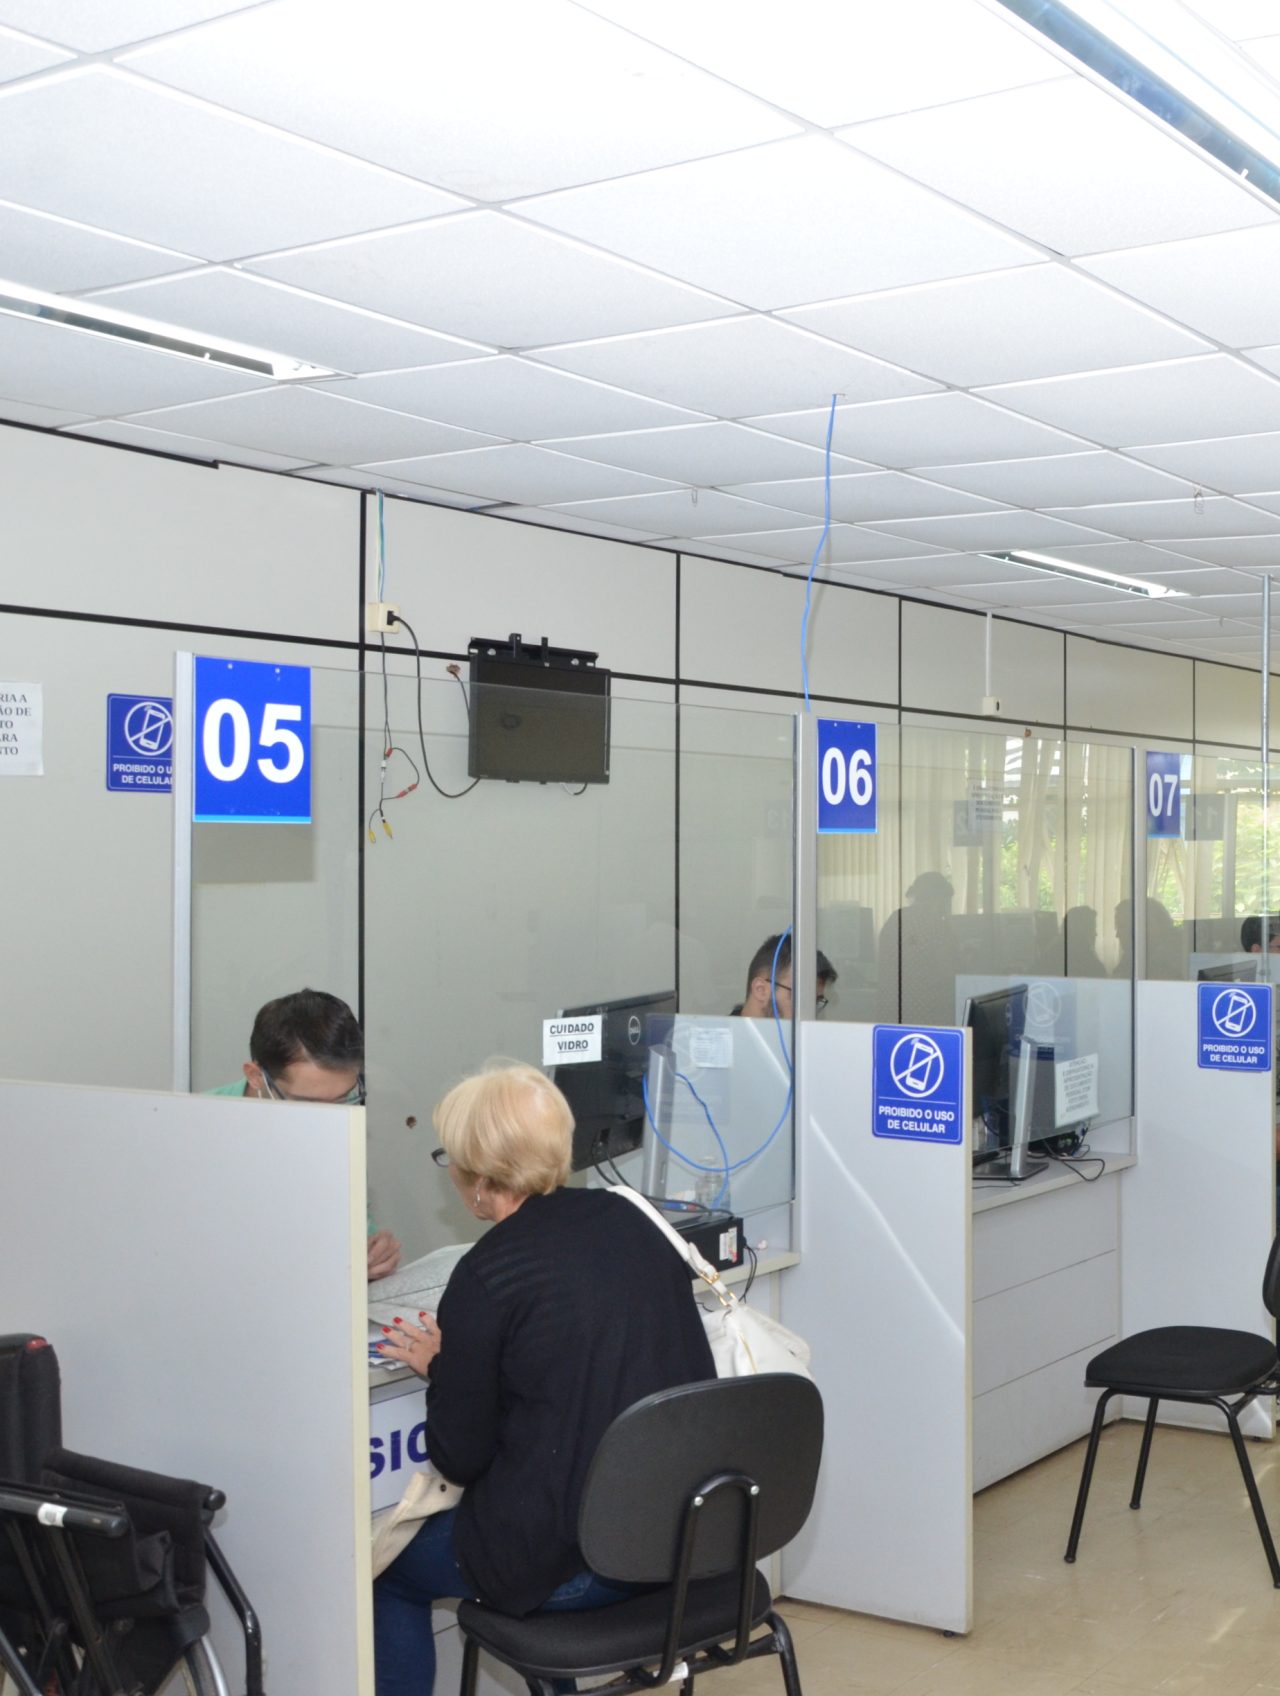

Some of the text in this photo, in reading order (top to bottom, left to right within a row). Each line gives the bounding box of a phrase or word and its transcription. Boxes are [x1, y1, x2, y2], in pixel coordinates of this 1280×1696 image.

[16, 707, 31, 716] DE
[203, 698, 304, 784] 05
[113, 763, 155, 773] PROIBIDO
[157, 765, 164, 774] O
[122, 774, 134, 783] DE
[821, 747, 873, 806] 06
[1149, 773, 1178, 817] 07
[550, 1023, 594, 1034] CUIDADO
[557, 1040, 588, 1050] VIDRO
[1203, 1044, 1239, 1053] PROIBIDO
[1248, 1046, 1265, 1054] USO
[1210, 1054, 1258, 1063] DE CELULAR
[879, 1105, 955, 1121] PROIBIDO O USO
[887, 1119, 946, 1134] DE CELULAR
